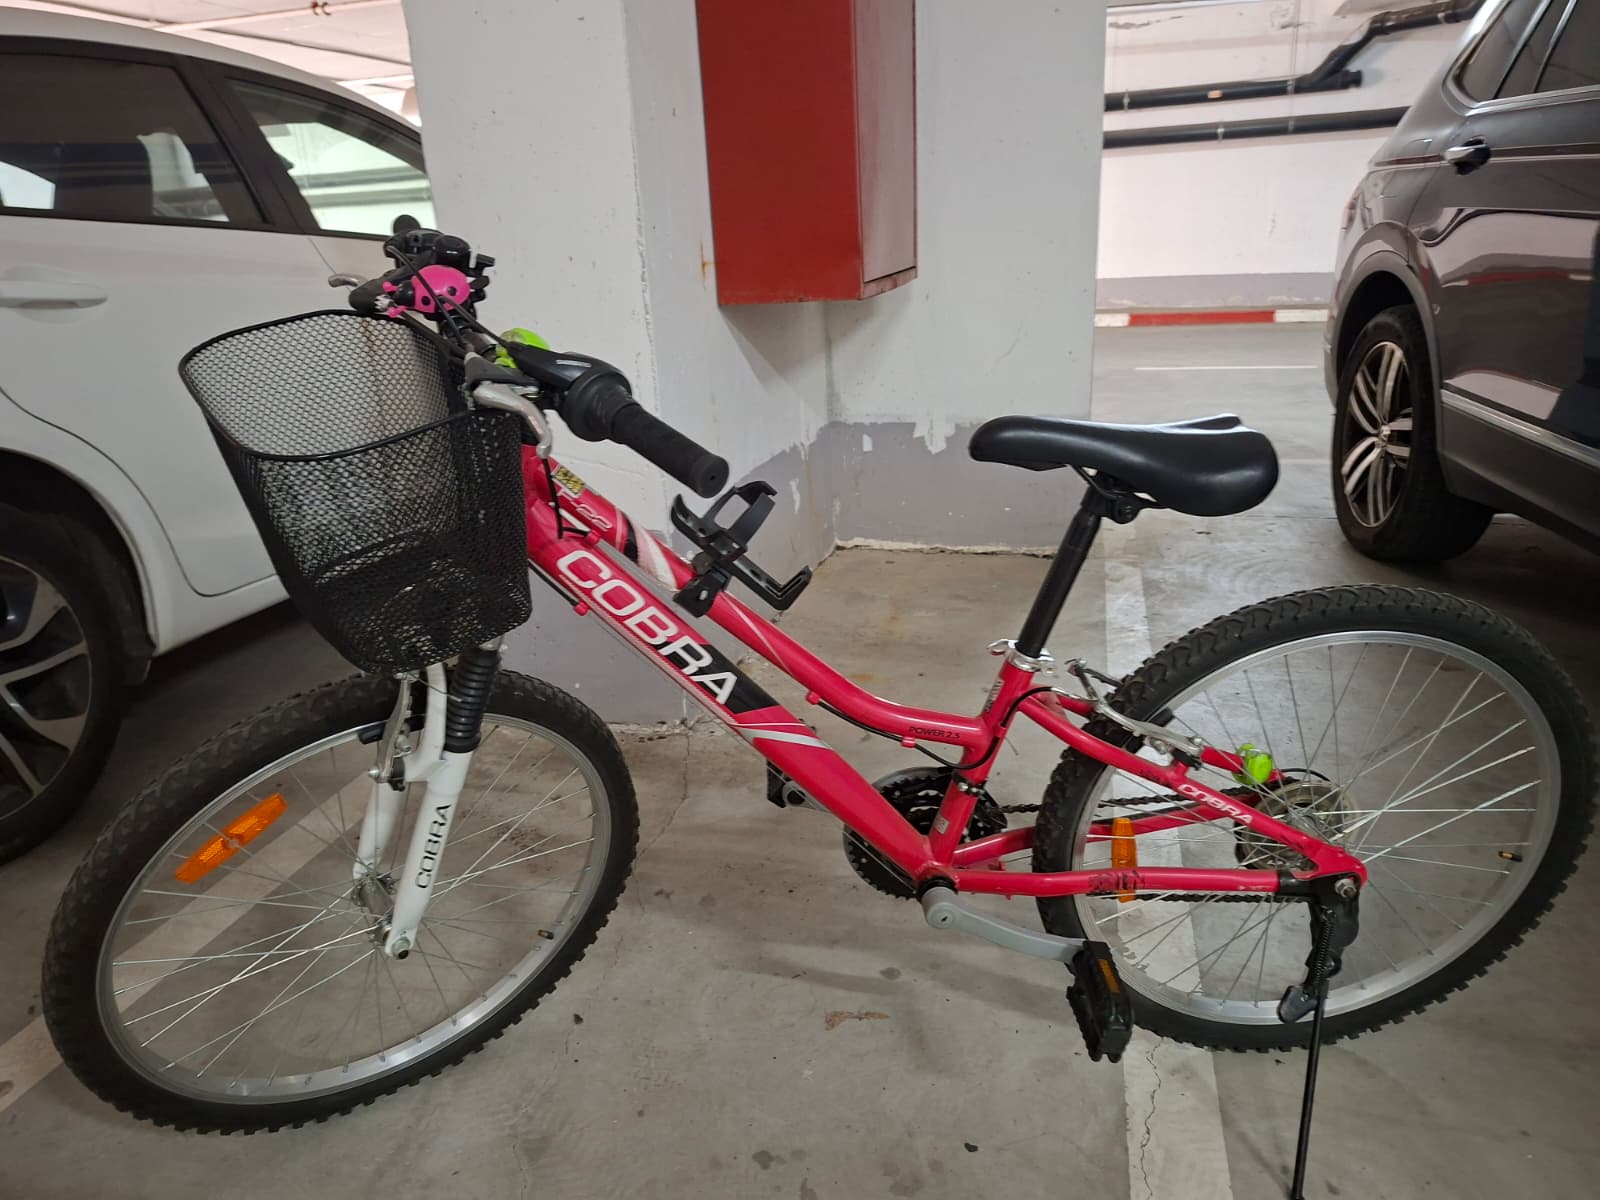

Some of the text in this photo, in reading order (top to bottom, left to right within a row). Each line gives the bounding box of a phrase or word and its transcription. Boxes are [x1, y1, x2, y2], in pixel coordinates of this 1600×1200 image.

[556, 550, 738, 705] COBRA
[908, 726, 961, 739] POWER 2.5
[1178, 784, 1253, 824] COBRA
[415, 804, 452, 889] COBRA
